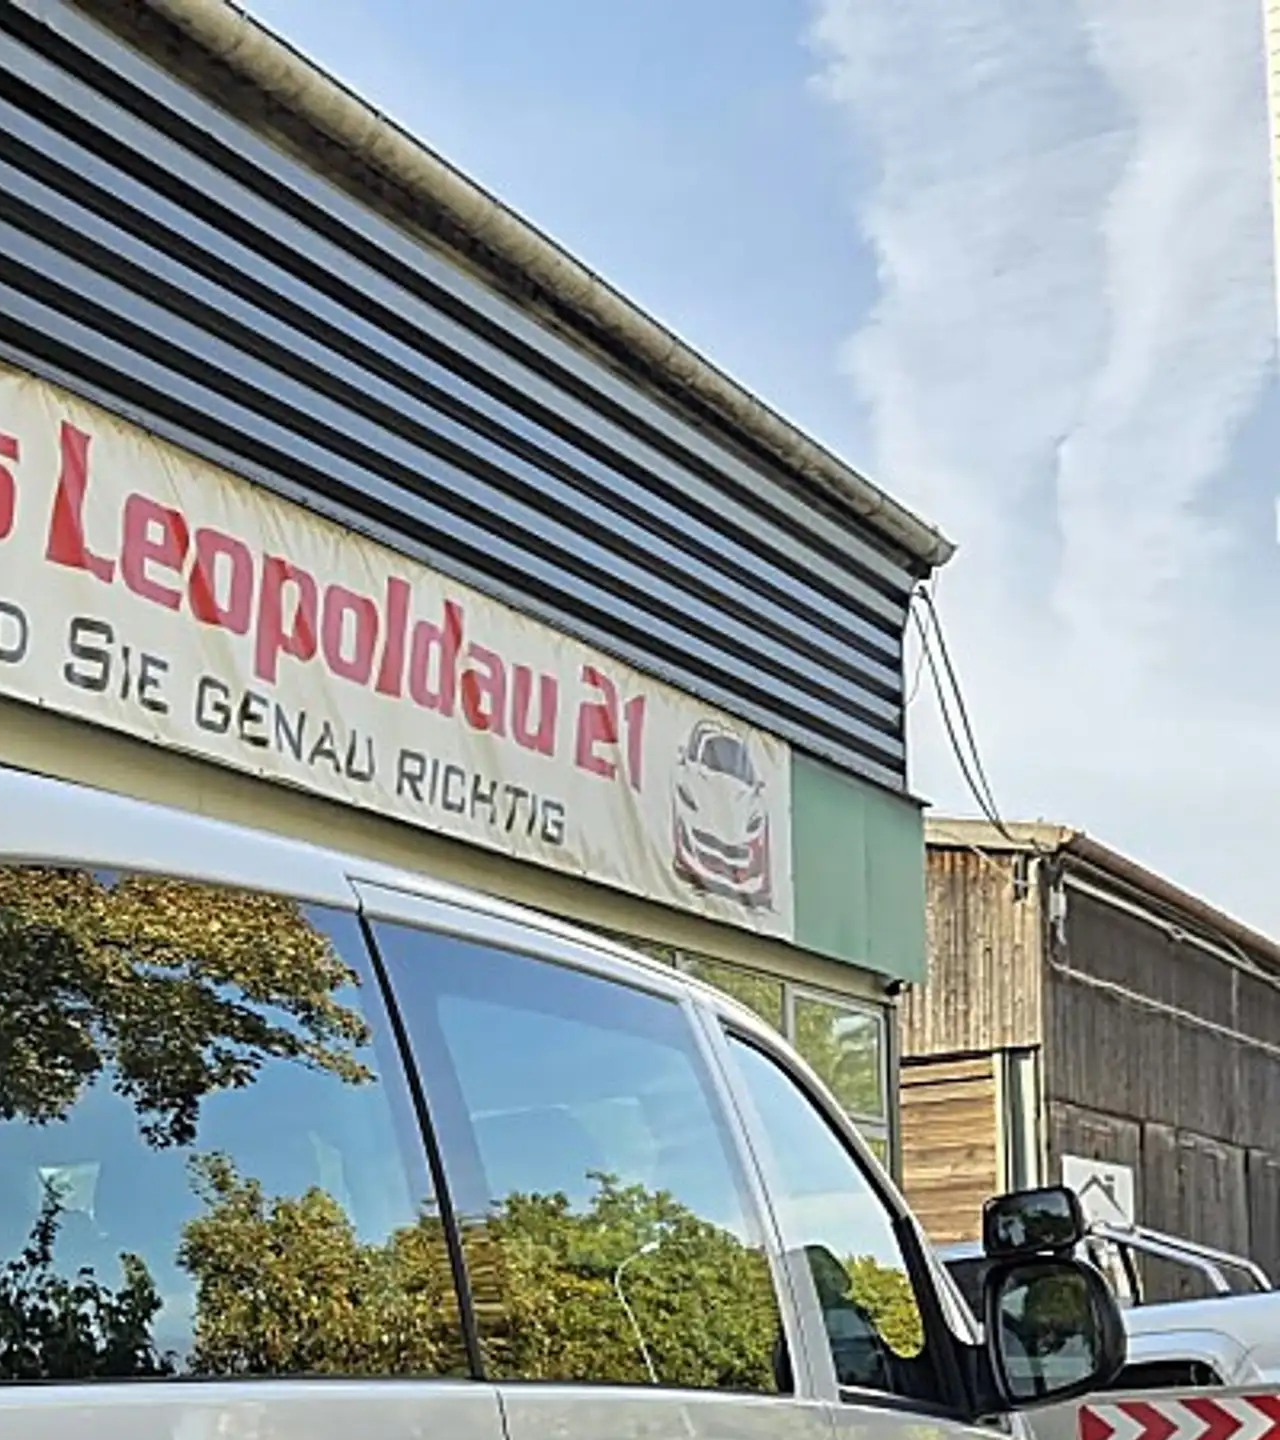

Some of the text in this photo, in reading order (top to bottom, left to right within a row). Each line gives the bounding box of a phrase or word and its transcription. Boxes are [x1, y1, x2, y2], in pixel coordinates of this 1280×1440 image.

[45, 420, 558, 757] Leopoldau
[575, 665, 646, 793] 21
[63, 616, 169, 715] SIE
[195, 675, 375, 783] GENAU
[396, 748, 565, 846] RICHTIG
